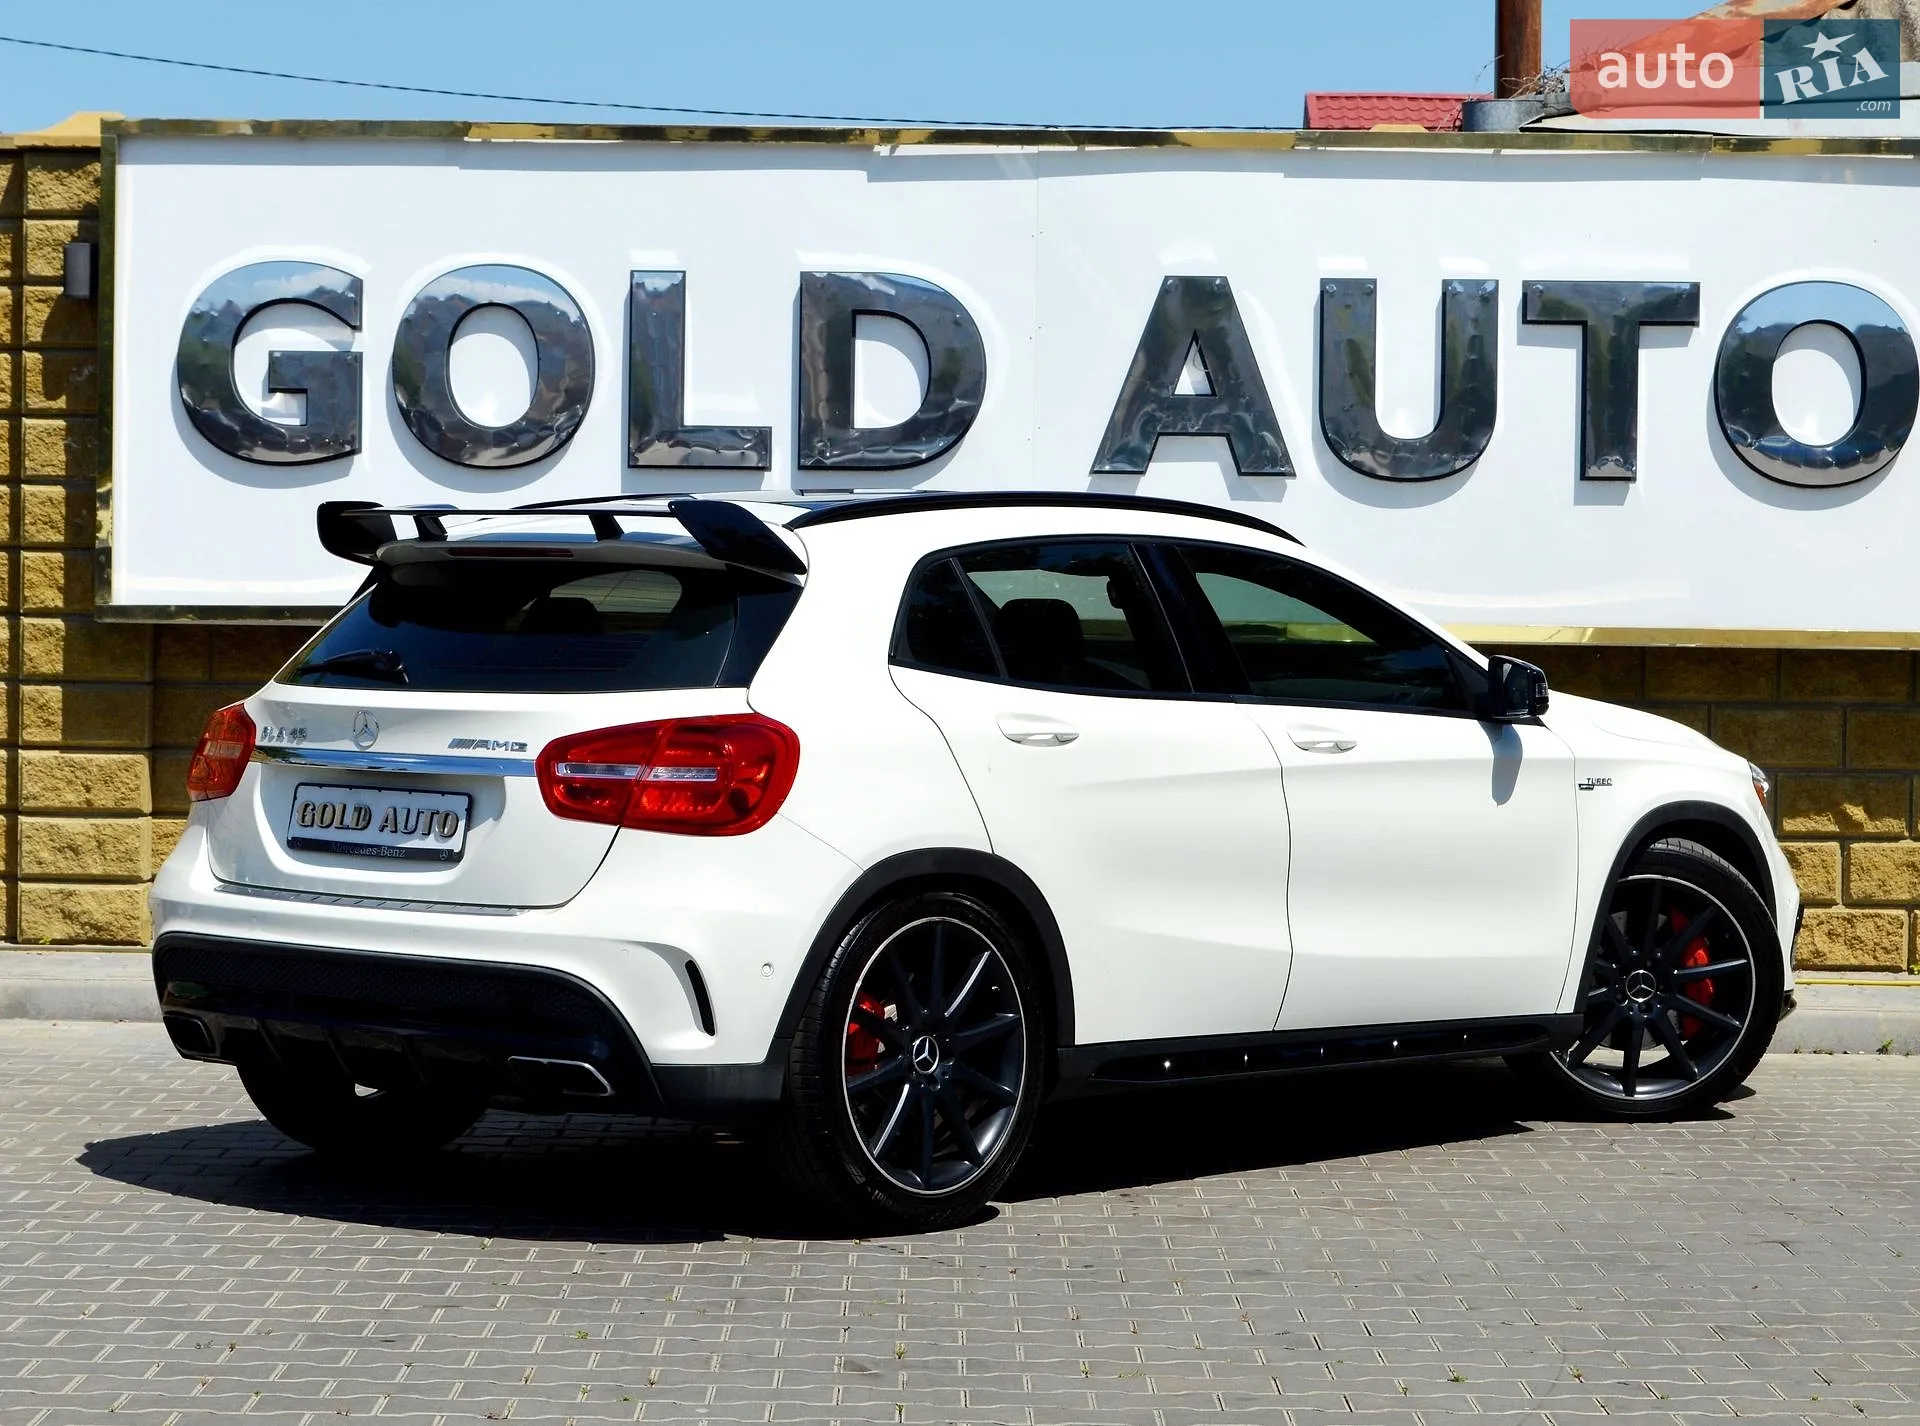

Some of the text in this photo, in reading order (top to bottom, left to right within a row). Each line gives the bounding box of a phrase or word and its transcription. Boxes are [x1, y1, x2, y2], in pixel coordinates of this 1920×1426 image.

[177, 260, 1919, 488] GOLD AUTO
[297, 800, 459, 838] GOLD AUTO
